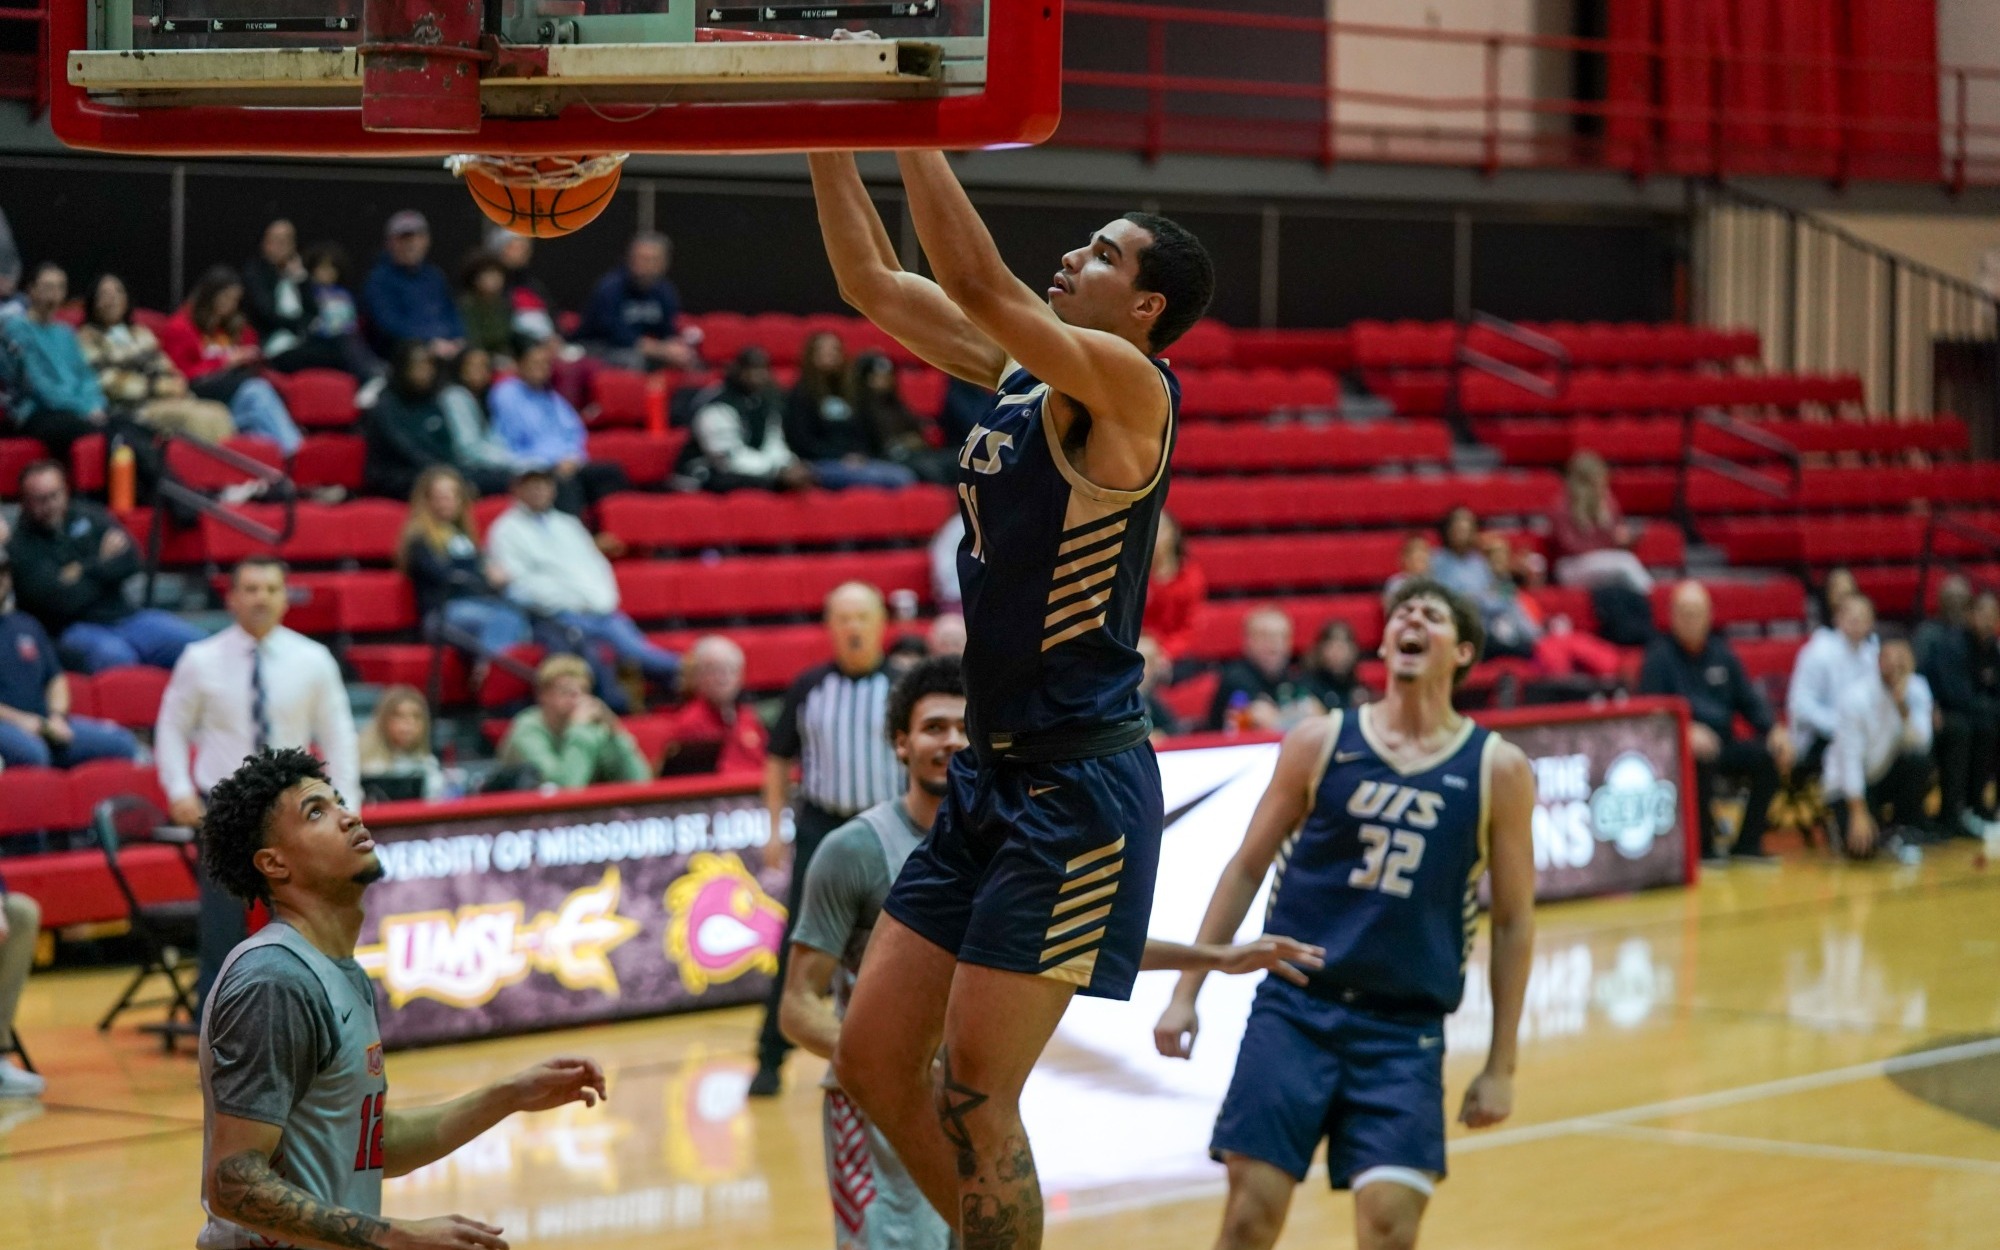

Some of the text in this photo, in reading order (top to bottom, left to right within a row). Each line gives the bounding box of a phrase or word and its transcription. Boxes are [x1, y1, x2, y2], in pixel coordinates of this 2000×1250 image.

[958, 422, 1014, 475] IS
[1346, 780, 1446, 830] UIS
[492, 829, 536, 873] OF
[536, 818, 674, 868] MISSOURI
[712, 807, 797, 849] LOUS
[1347, 823, 1427, 898] 32
[386, 908, 528, 998] UMSL
